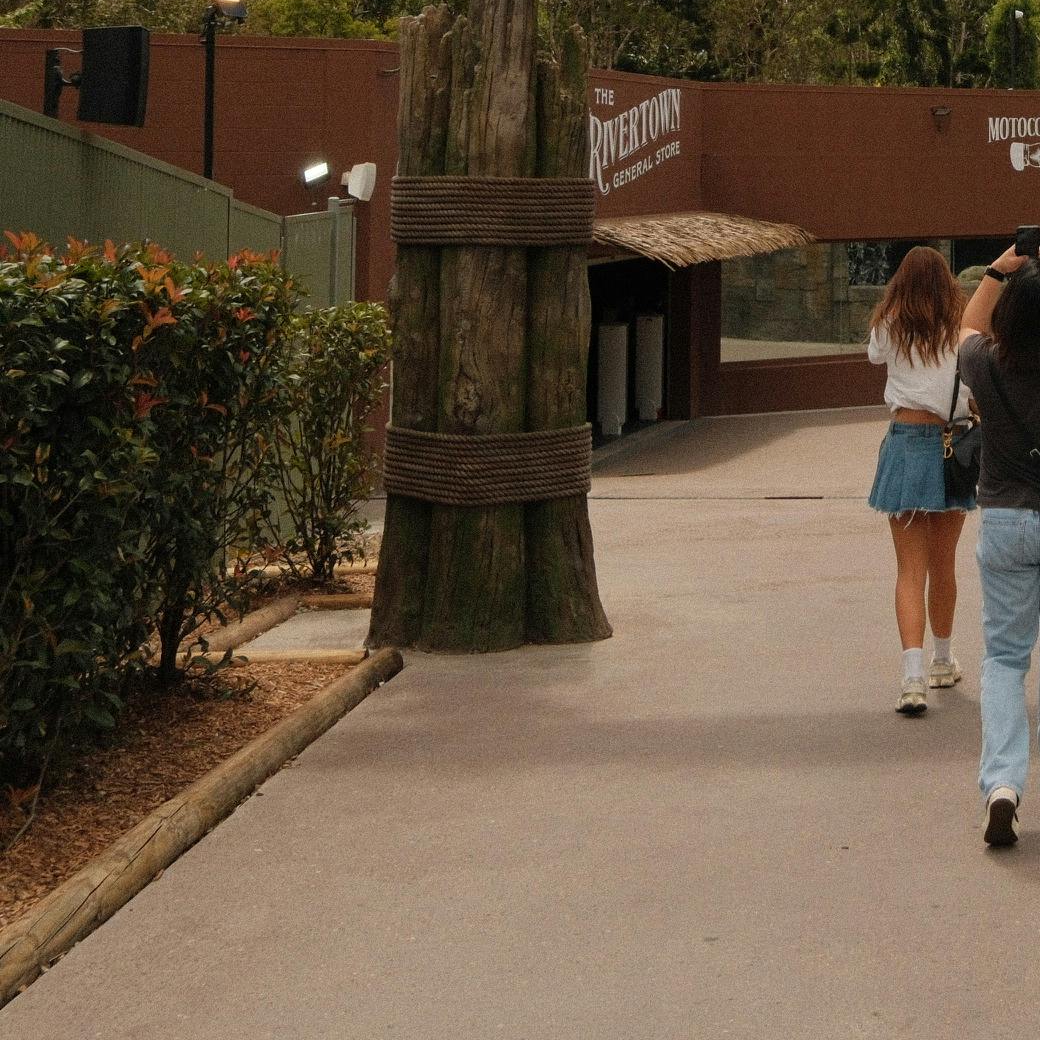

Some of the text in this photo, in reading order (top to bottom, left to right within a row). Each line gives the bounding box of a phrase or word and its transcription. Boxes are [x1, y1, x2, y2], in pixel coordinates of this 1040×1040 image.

[594, 87, 615, 106] THE
[588, 88, 682, 196] RIVERTOWN
[613, 141, 680, 189] GENERAL STORE
